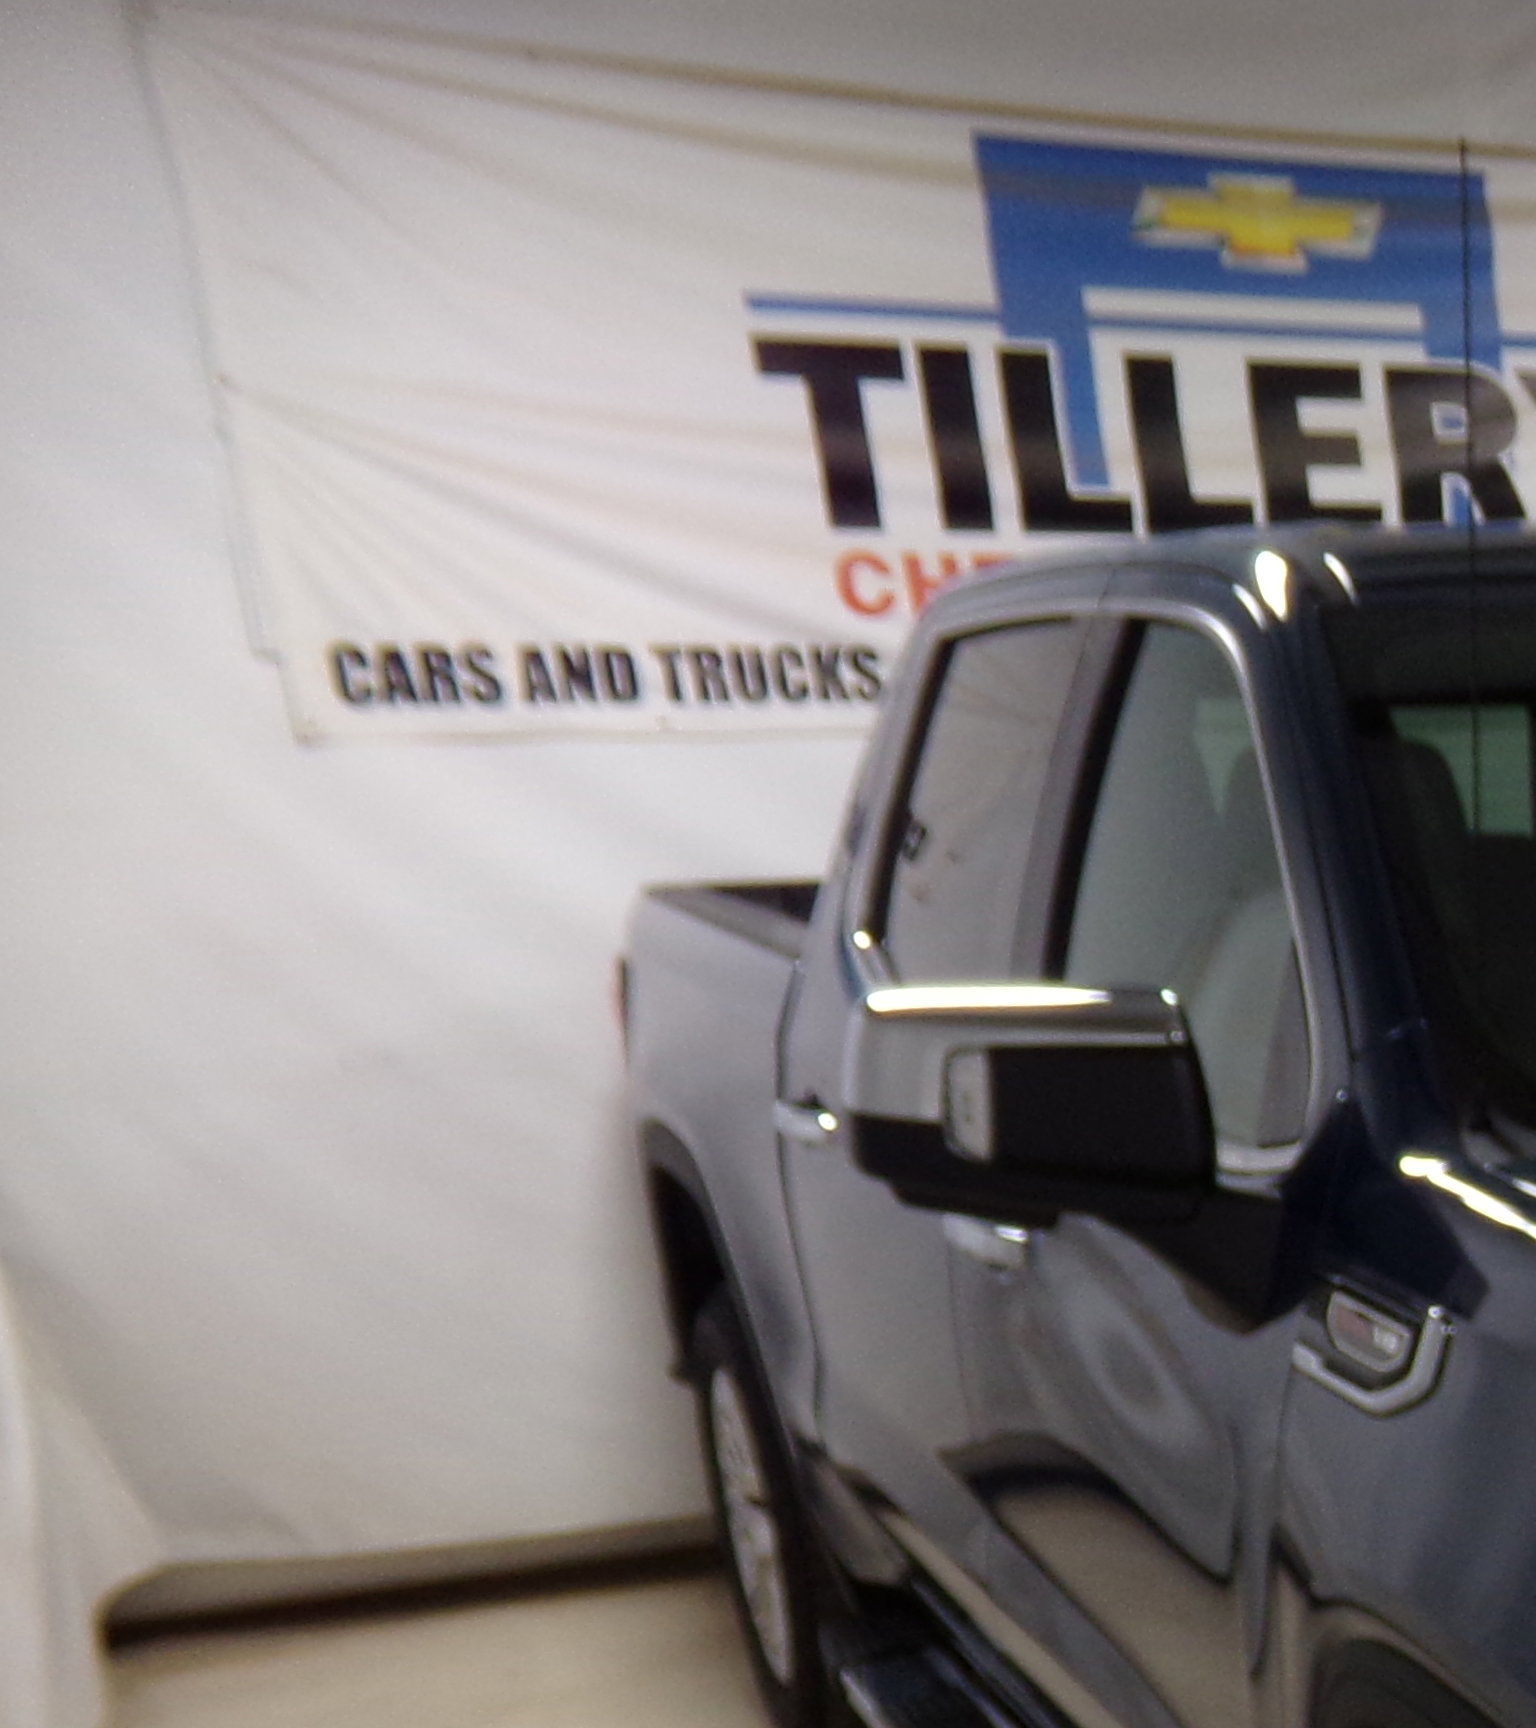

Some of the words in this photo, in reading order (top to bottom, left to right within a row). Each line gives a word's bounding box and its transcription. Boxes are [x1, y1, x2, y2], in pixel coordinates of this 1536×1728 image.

[833, 550, 1013, 620] CH
[332, 641, 503, 704] CARS
[517, 642, 639, 704] AND
[648, 643, 883, 704] TRUCKS
